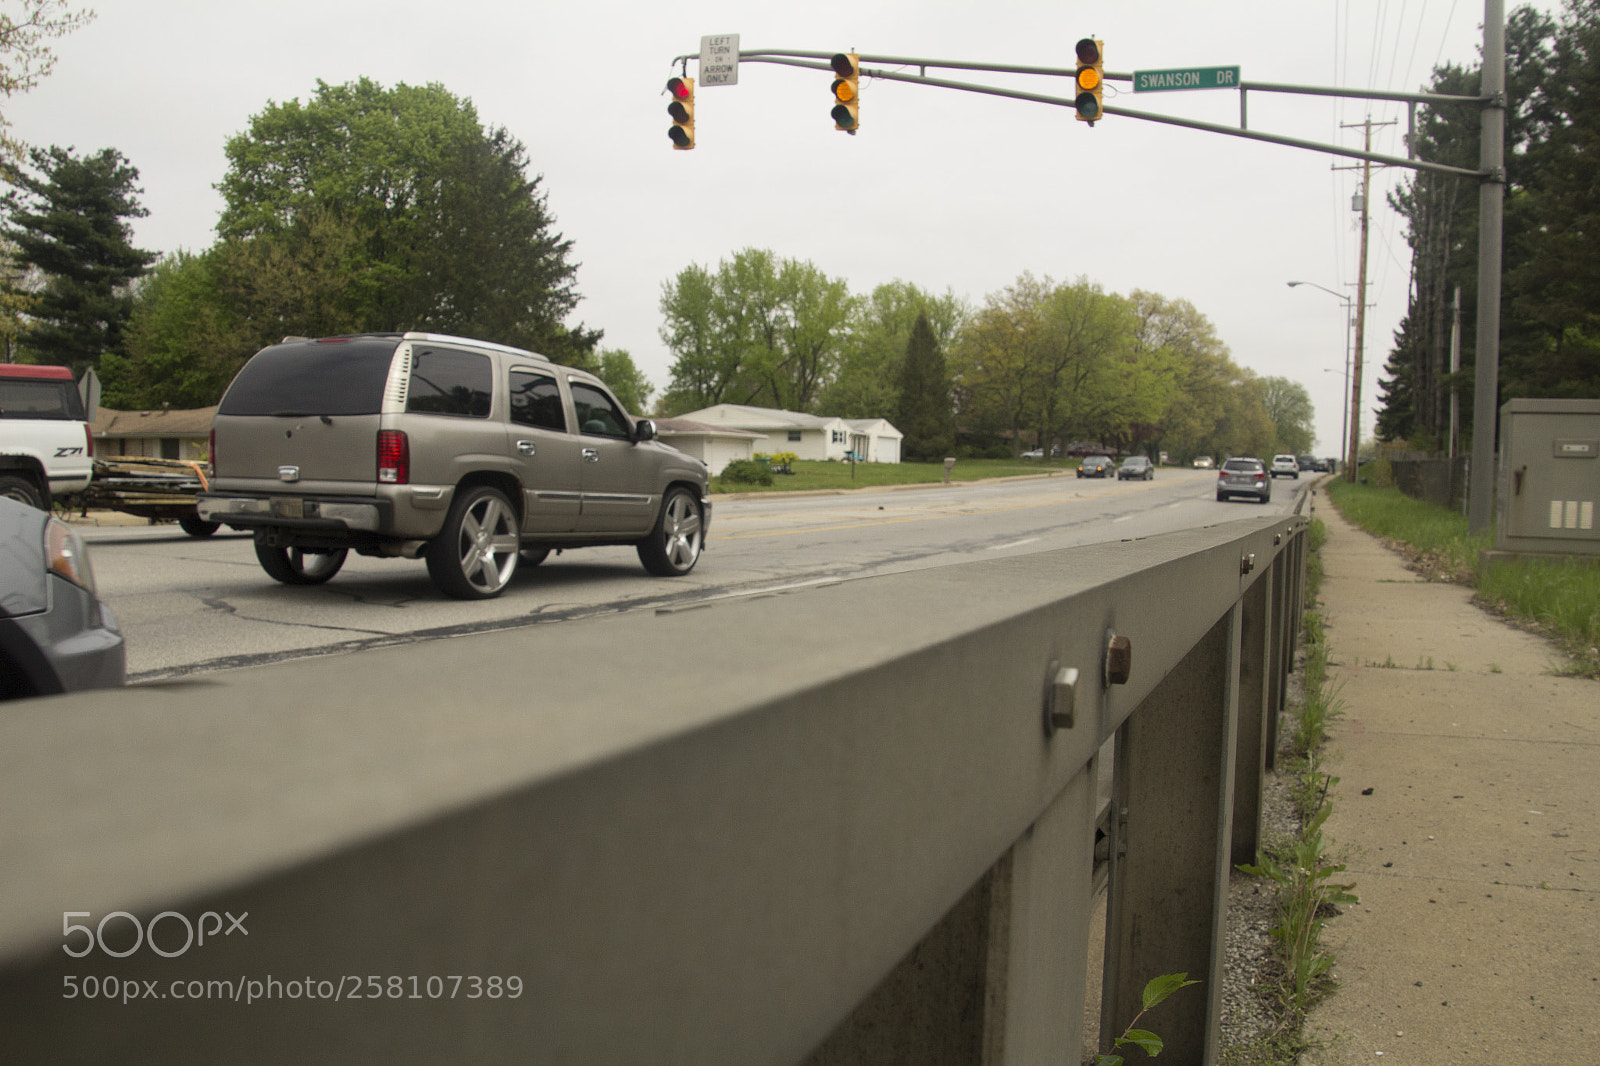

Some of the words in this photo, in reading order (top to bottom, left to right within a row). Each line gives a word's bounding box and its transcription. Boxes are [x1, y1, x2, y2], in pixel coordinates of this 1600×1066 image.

[709, 37, 730, 46] LEFT
[709, 46, 731, 54] TURN
[704, 64, 734, 73] ARROW
[706, 73, 729, 83] ONLY
[1141, 72, 1200, 88] SWANSON
[1216, 70, 1234, 84] DR
[53, 447, 83, 458] Z71
